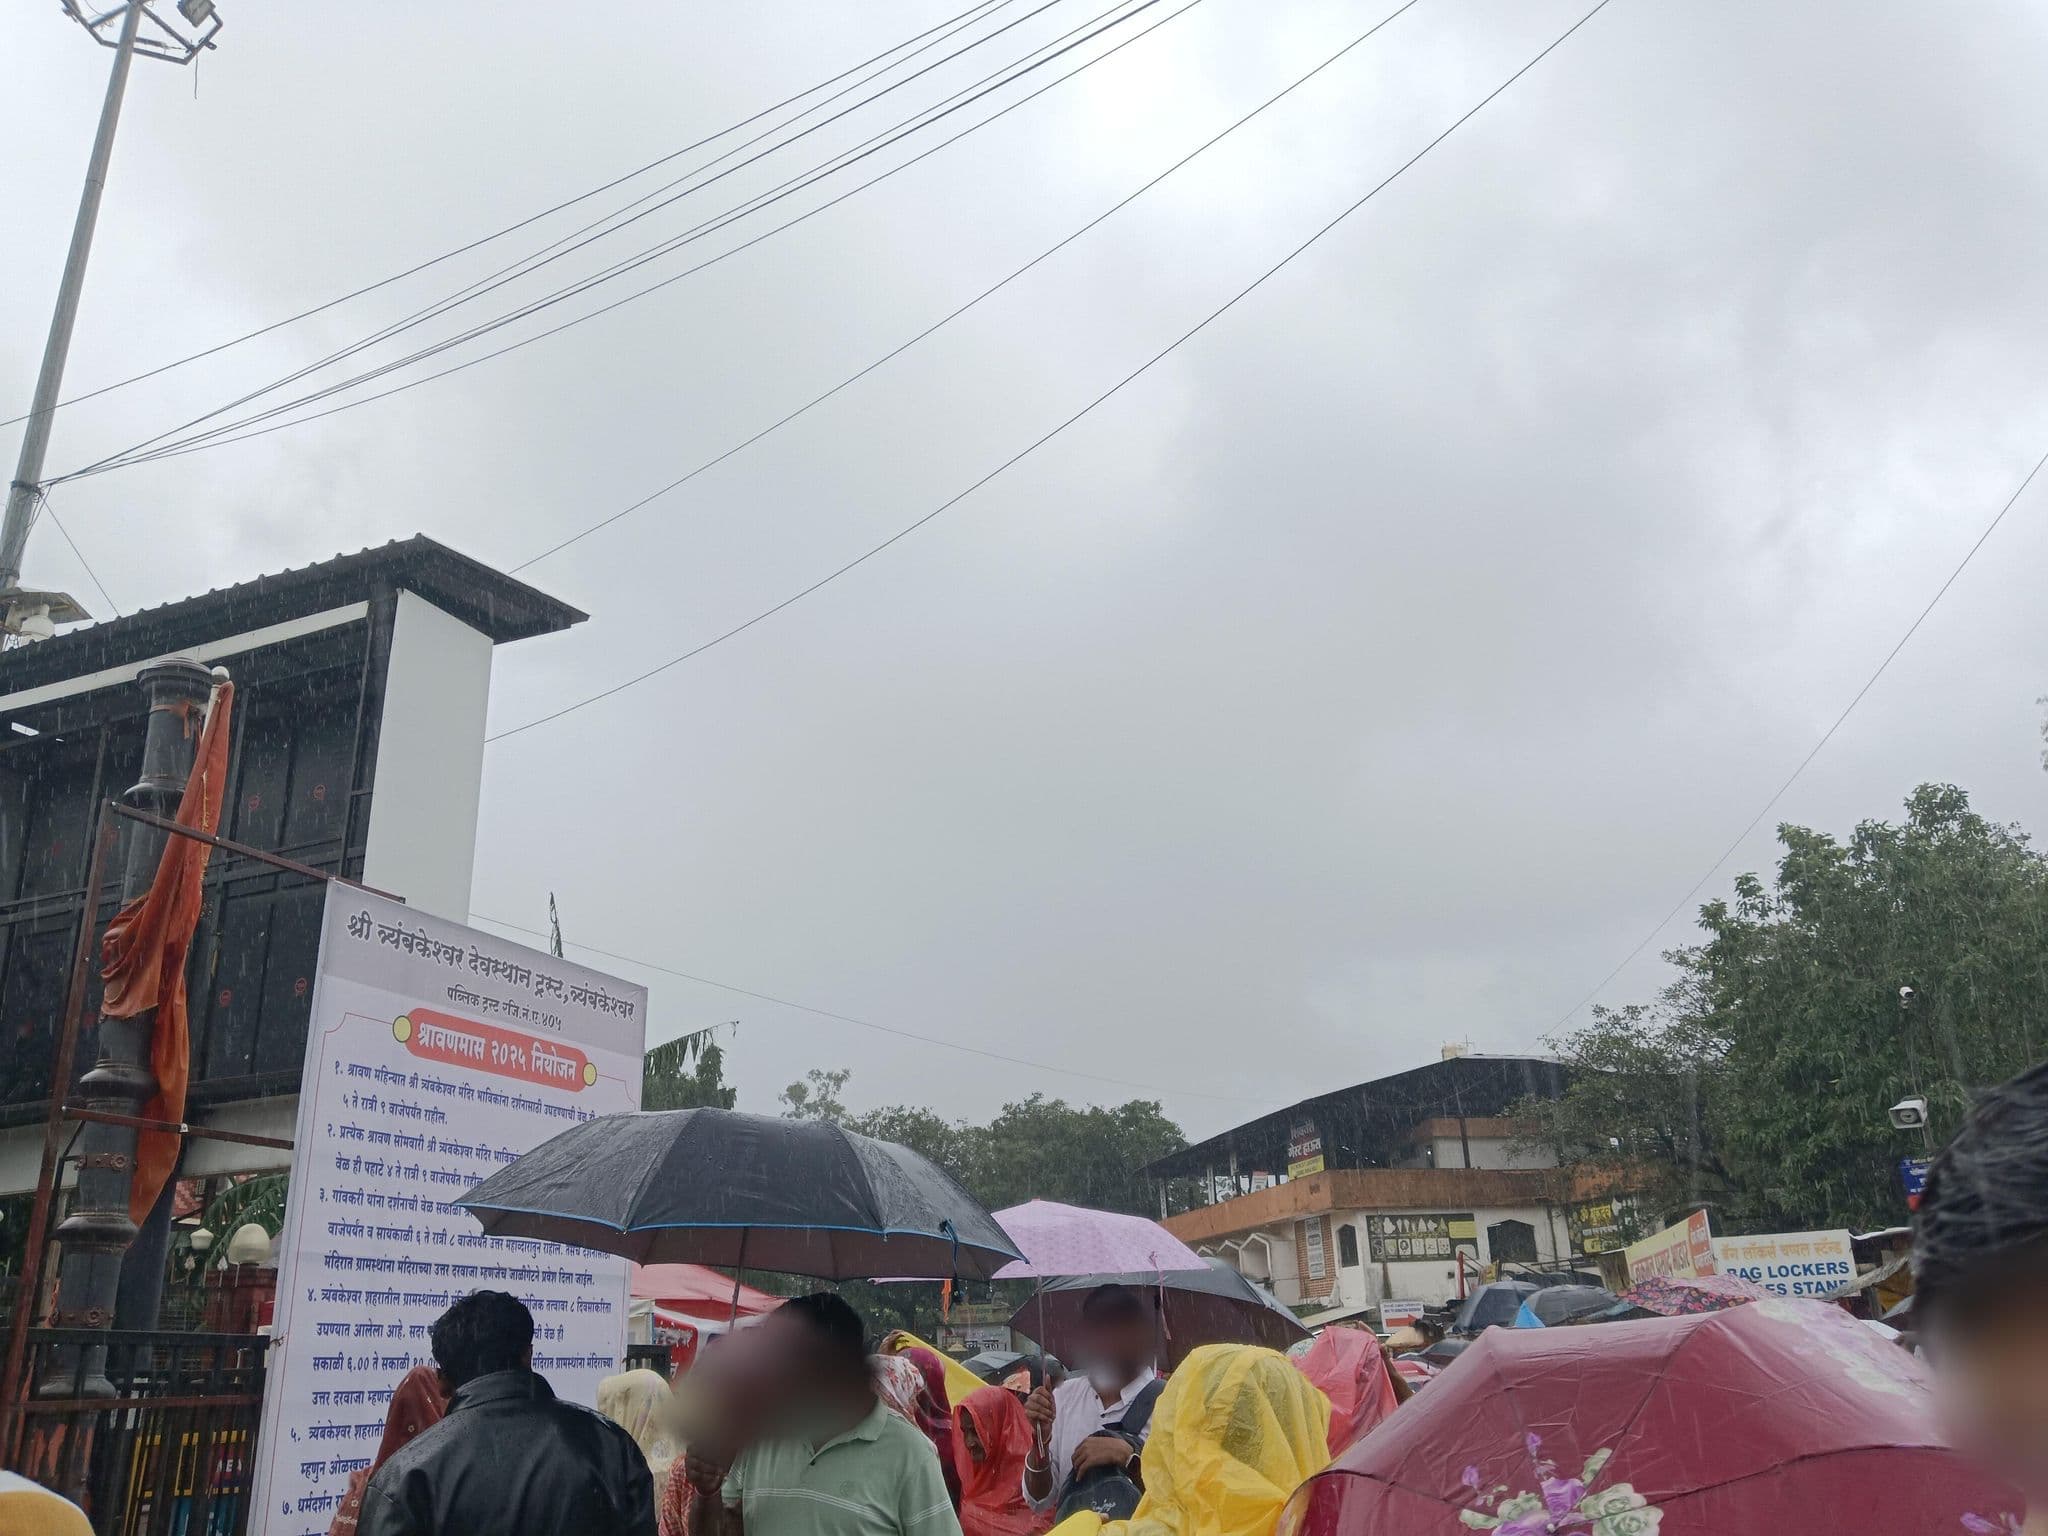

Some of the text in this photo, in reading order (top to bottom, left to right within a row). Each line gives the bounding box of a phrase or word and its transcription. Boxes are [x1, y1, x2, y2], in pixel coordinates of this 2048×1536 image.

[347, 911, 372, 940] श्री
[469, 945, 532, 988] देवस्थान
[482, 997, 499, 1013] ट्रस्ट
[418, 1022, 577, 1080] श्रावणमास २०२५ नियोजन
[348, 1063, 371, 1080] श्रावण
[374, 1065, 406, 1086] महिन्यात
[409, 1072, 418, 1089] श्री
[458, 1082, 475, 1100] मंदिर
[477, 1087, 509, 1107] भाविकांना
[511, 1094, 542, 1113] दर्शनासाठी
[352, 1090, 358, 1109] ते
[361, 1095, 377, 1112] रात्री
[381, 1101, 385, 1114] ९
[389, 1100, 421, 1120] वाजेपर्यंत
[424, 1107, 447, 1124] राहील.
[340, 1121, 364, 1141] प्रत्येक
[368, 1130, 391, 1145] श्रावण
[394, 1130, 424, 1151] सोमवारी
[427, 1136, 436, 1152] श्री
[475, 1144, 491, 1162] मंदिर
[336, 1152, 349, 1170] वेळ
[353, 1155, 361, 1174] ही
[365, 1157, 384, 1176] पहाटे
[387, 1165, 393, 1177] ४
[395, 1160, 401, 1177] ते
[404, 1164, 419, 1180] रात्री
[422, 1170, 427, 1182] ९
[430, 1167, 460, 1186] वाजेपर्यंत
[332, 1185, 364, 1206] गांवकरी
[366, 1189, 384, 1208] यांना
[387, 1192, 418, 1211] दर्शनाची
[420, 1195, 433, 1213] वेळ
[328, 1217, 363, 1239] वाजेपर्यंत
[367, 1226, 374, 1241] व
[376, 1223, 413, 1243] सायंकाळी
[416, 1230, 421, 1246] ६
[424, 1226, 430, 1244] ते
[432, 1228, 447, 1246] रात्री
[449, 1234, 455, 1247] ८
[324, 1250, 353, 1271] मंदिरात
[356, 1253, 395, 1273] ग्रामस्थांना
[397, 1255, 432, 1276] मंदिराच्या
[434, 1264, 449, 1278] उत्तर
[451, 1265, 478, 1279] दरवाजा
[480, 1262, 507, 1281] म्हणजेच
[541, 1266, 557, 1284] प्रवेश
[558, 1267, 573, 1285] दिला
[575, 1269, 595, 1289] जाईल.
[1768, 1261, 1850, 1279] LOCKERS
[307, 1288, 317, 1301] ४.
[365, 1287, 400, 1307] शहरातील
[403, 1289, 448, 1308] ग्रामस्थांसाठी
[570, 1301, 575, 1313] ८
[353, 1318, 384, 1338] आलेला
[386, 1319, 406, 1339] आहे.
[409, 1325, 425, 1339] सदर
[544, 1323, 555, 1341] वेळ
[557, 1324, 564, 1342] ही
[312, 1351, 344, 1371] सकाळी
[372, 1351, 378, 1370] ते
[381, 1352, 410, 1371] सकाळी
[555, 1353, 585, 1369] ग्रामस्थांना
[587, 1353, 613, 1370] मंदिराच्या
[312, 1384, 396, 1405] उत्तर दरवाजा म्हणजे
[290, 1418, 385, 1442] ५. त्र्यंबकेश्वर शहराती
[300, 1461, 326, 1483] म्हणुन
[282, 1500, 293, 1515] ७.
[298, 1490, 332, 1514] धर्मदर्शन
